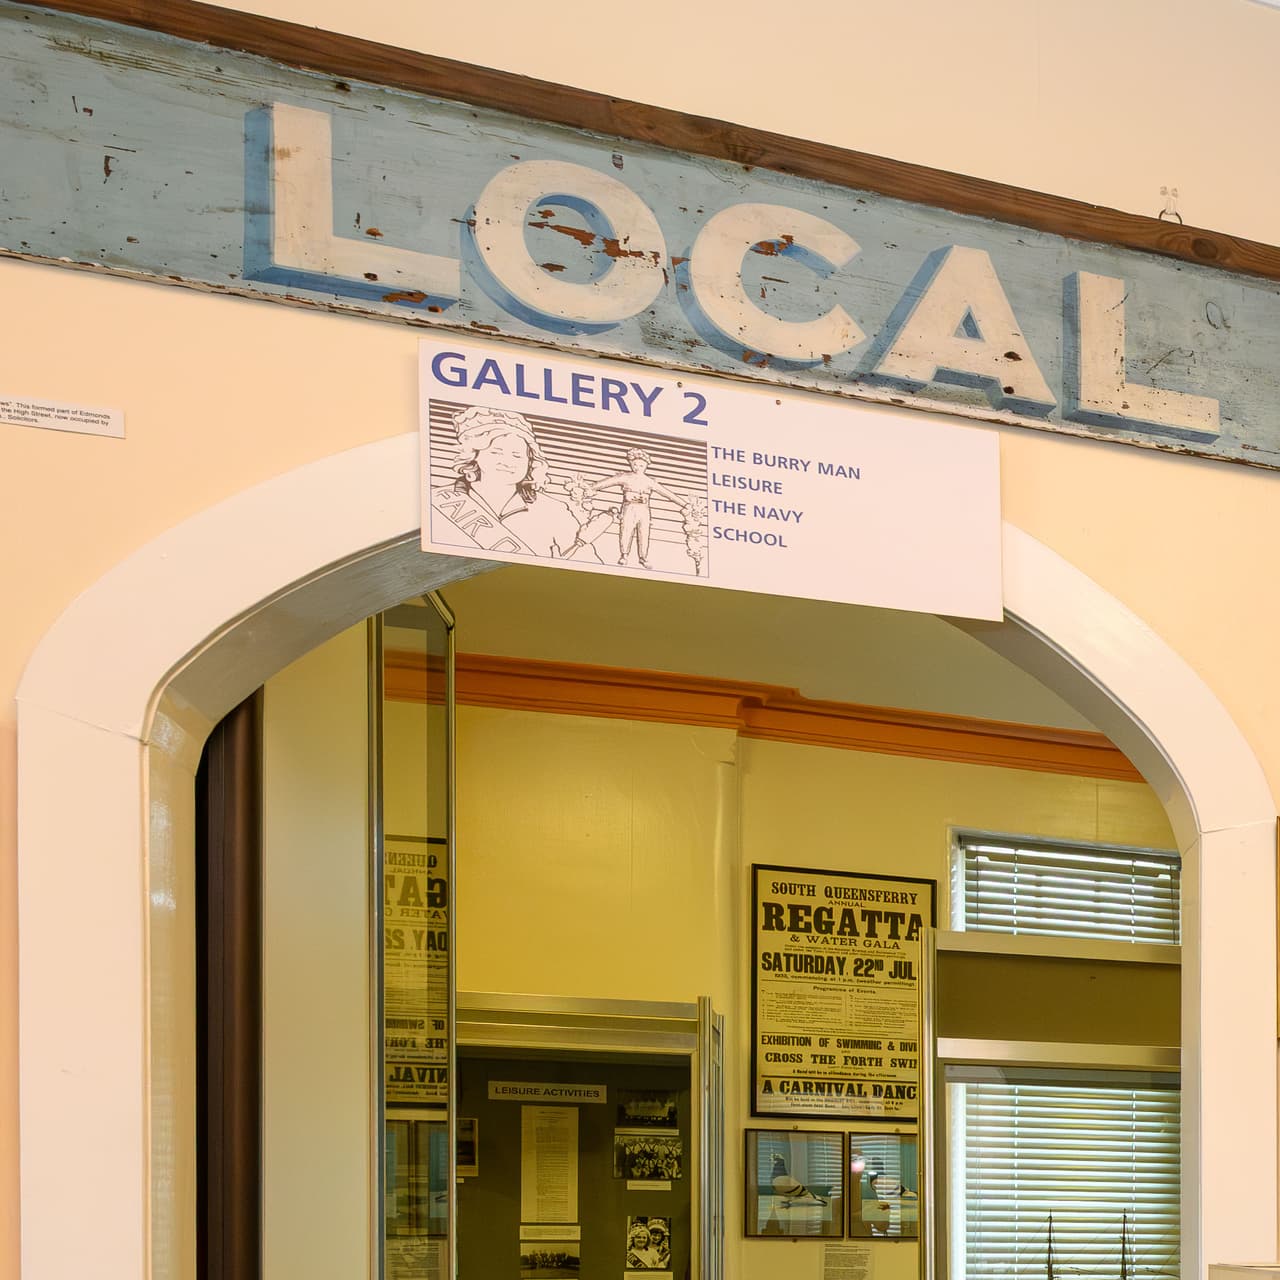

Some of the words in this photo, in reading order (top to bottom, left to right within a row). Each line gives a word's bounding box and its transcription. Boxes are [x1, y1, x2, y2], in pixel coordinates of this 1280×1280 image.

[245, 101, 1222, 455] LOCAL
[430, 350, 664, 418] GALLERY
[682, 391, 710, 426] 2
[14, 408, 30, 416] High
[70, 416, 100, 425] occupied
[101, 419, 109, 427] by
[16, 402, 30, 410] This
[32, 404, 55, 413] formed
[80, 410, 111, 420] Edmonds
[711, 446, 746, 464] THE
[752, 451, 811, 473] BURRY
[817, 461, 861, 481] MAN
[711, 472, 783, 495] LEISURE
[436, 489, 494, 537] FAIR
[711, 499, 747, 517] THE
[753, 505, 803, 524] NAVY
[712, 526, 788, 548] SCHOOL
[771, 881, 817, 897] SOUTH
[824, 885, 918, 905] QUEENSFERRY
[762, 901, 923, 942] REGATTA
[790, 934, 801, 943] &
[806, 935, 858, 947] WATER
[863, 939, 901, 950] GALA
[888, 960, 917, 981] JUL
[761, 1034, 812, 1047] EXHIBITION
[818, 1037, 831, 1048] OF
[836, 1038, 882, 1050] SWIMMING
[887, 1040, 896, 1051] &
[765, 1052, 803, 1064] CROSS
[811, 1053, 836, 1065] THE
[843, 1055, 883, 1067] FORTH
[495, 1086, 540, 1096] LEISURE
[543, 1087, 600, 1098] ACTIVITIES
[762, 1079, 775, 1095] A
[779, 1080, 868, 1098] CARNIVAL
[872, 1084, 917, 1100] DANC
